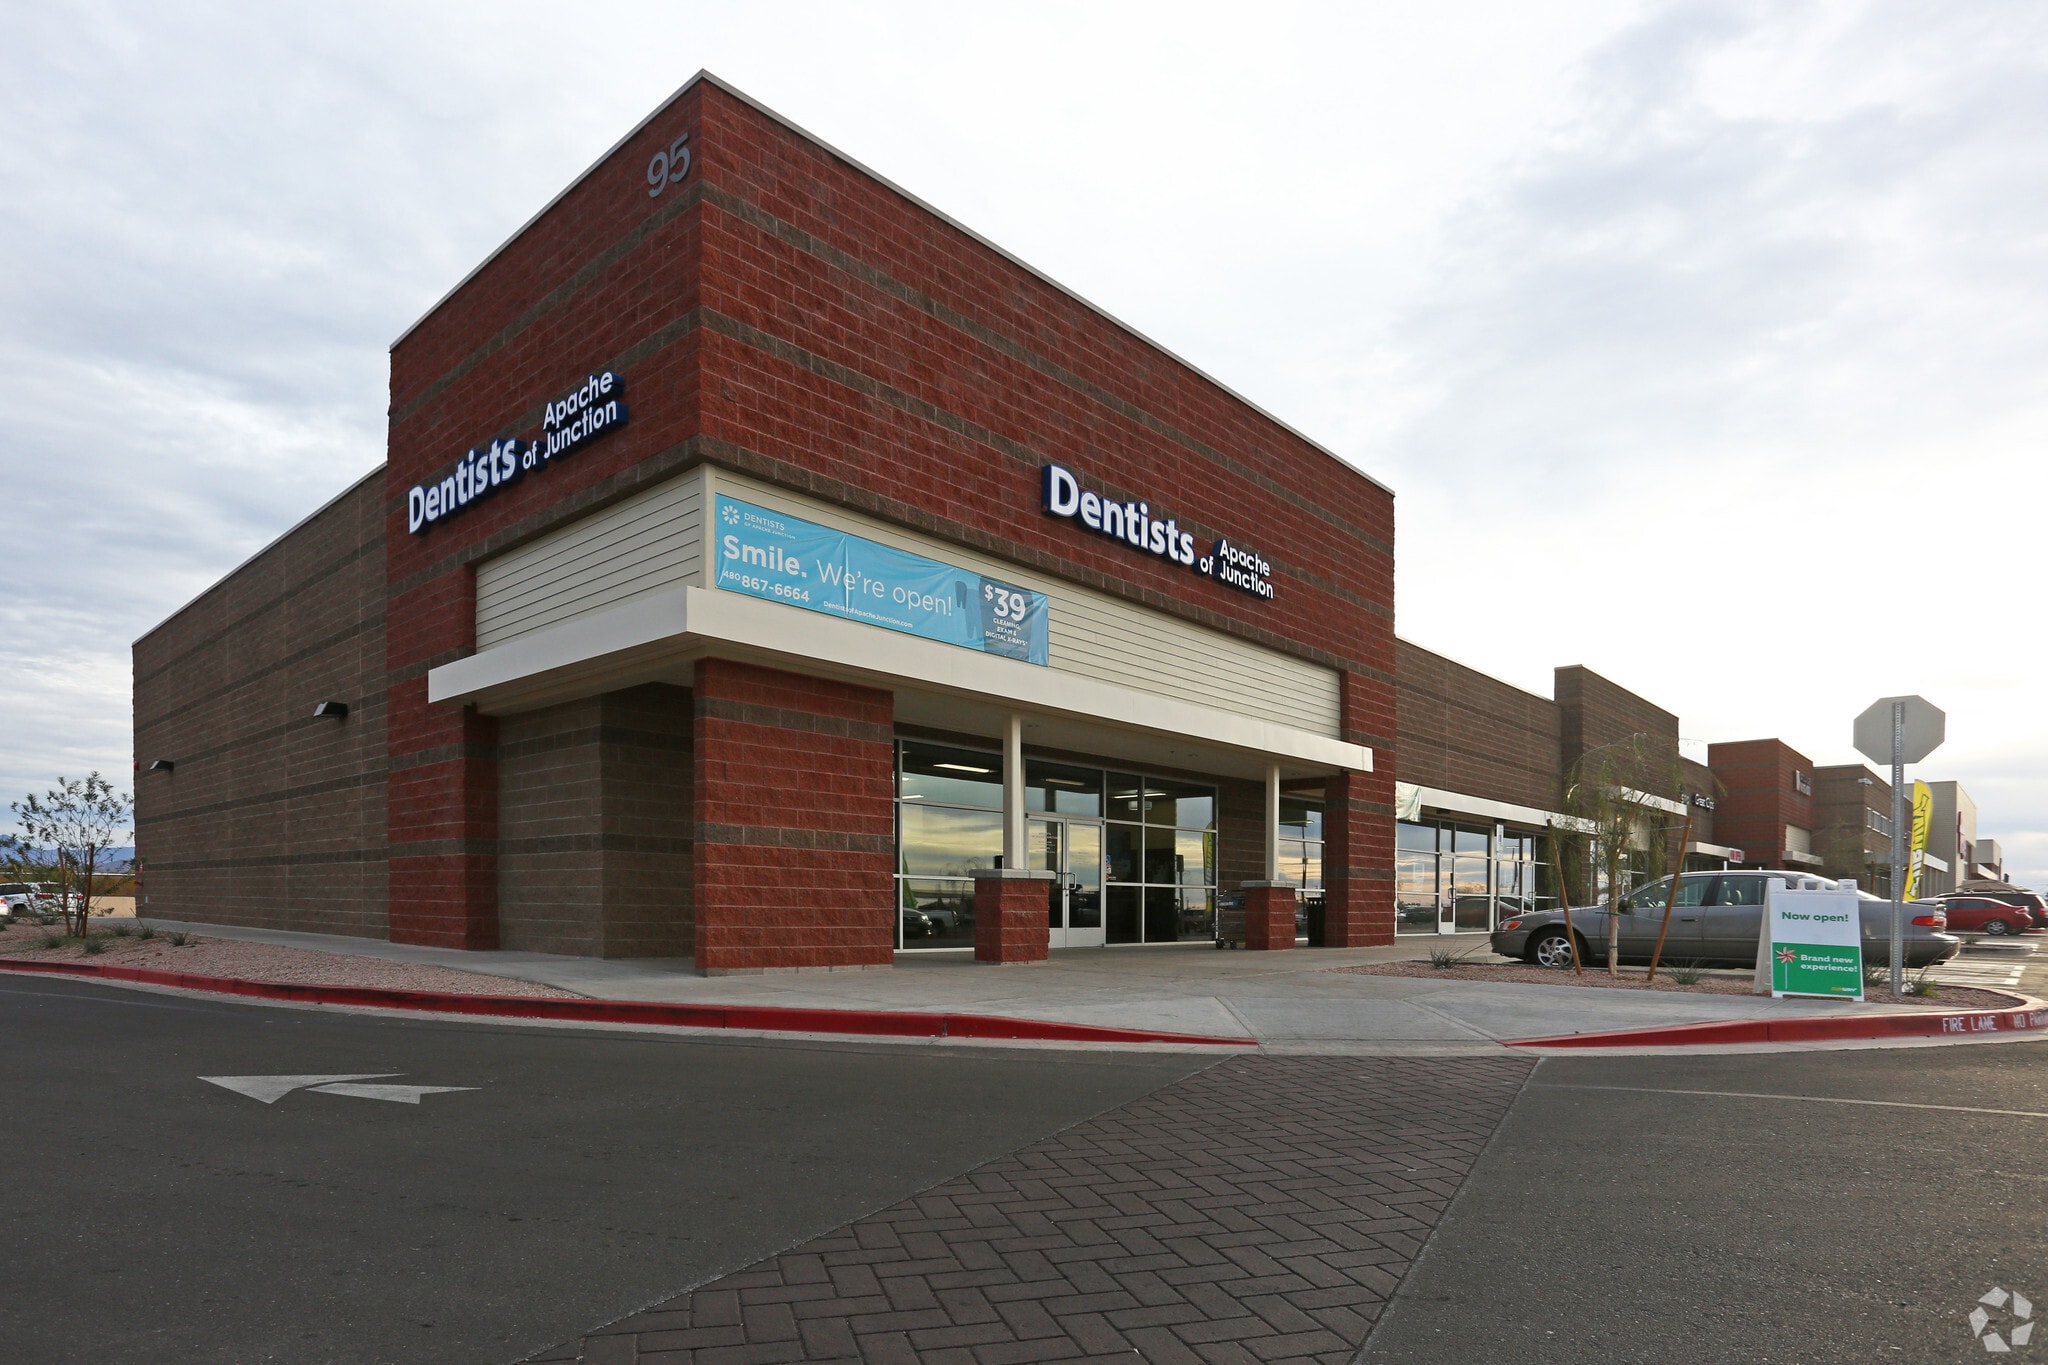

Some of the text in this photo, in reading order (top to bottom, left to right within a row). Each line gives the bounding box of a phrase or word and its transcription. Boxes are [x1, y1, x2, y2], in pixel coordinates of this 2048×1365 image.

[647, 132, 691, 198] 95
[543, 370, 615, 430] Apache
[543, 400, 618, 460] Junction
[409, 438, 538, 535] Dentists of
[744, 512, 785, 531] DENTISTS
[1050, 465, 1214, 575] Dentists of
[722, 534, 953, 618] Smile. We're open!
[1219, 539, 1271, 577] Apache
[741, 573, 810, 603] 867-6664
[1219, 562, 1274, 599] Junction
[984, 584, 1026, 622] $39
[985, 630, 1007, 641] DIGITAL
[1781, 911, 1849, 923] Now open!
[1800, 954, 1831, 963] Brand
[1800, 964, 1858, 973] experience!
[1942, 1017, 1966, 1033] FIRE
[1970, 1015, 1998, 1031] LANE
[2012, 1014, 2026, 1029] NO
